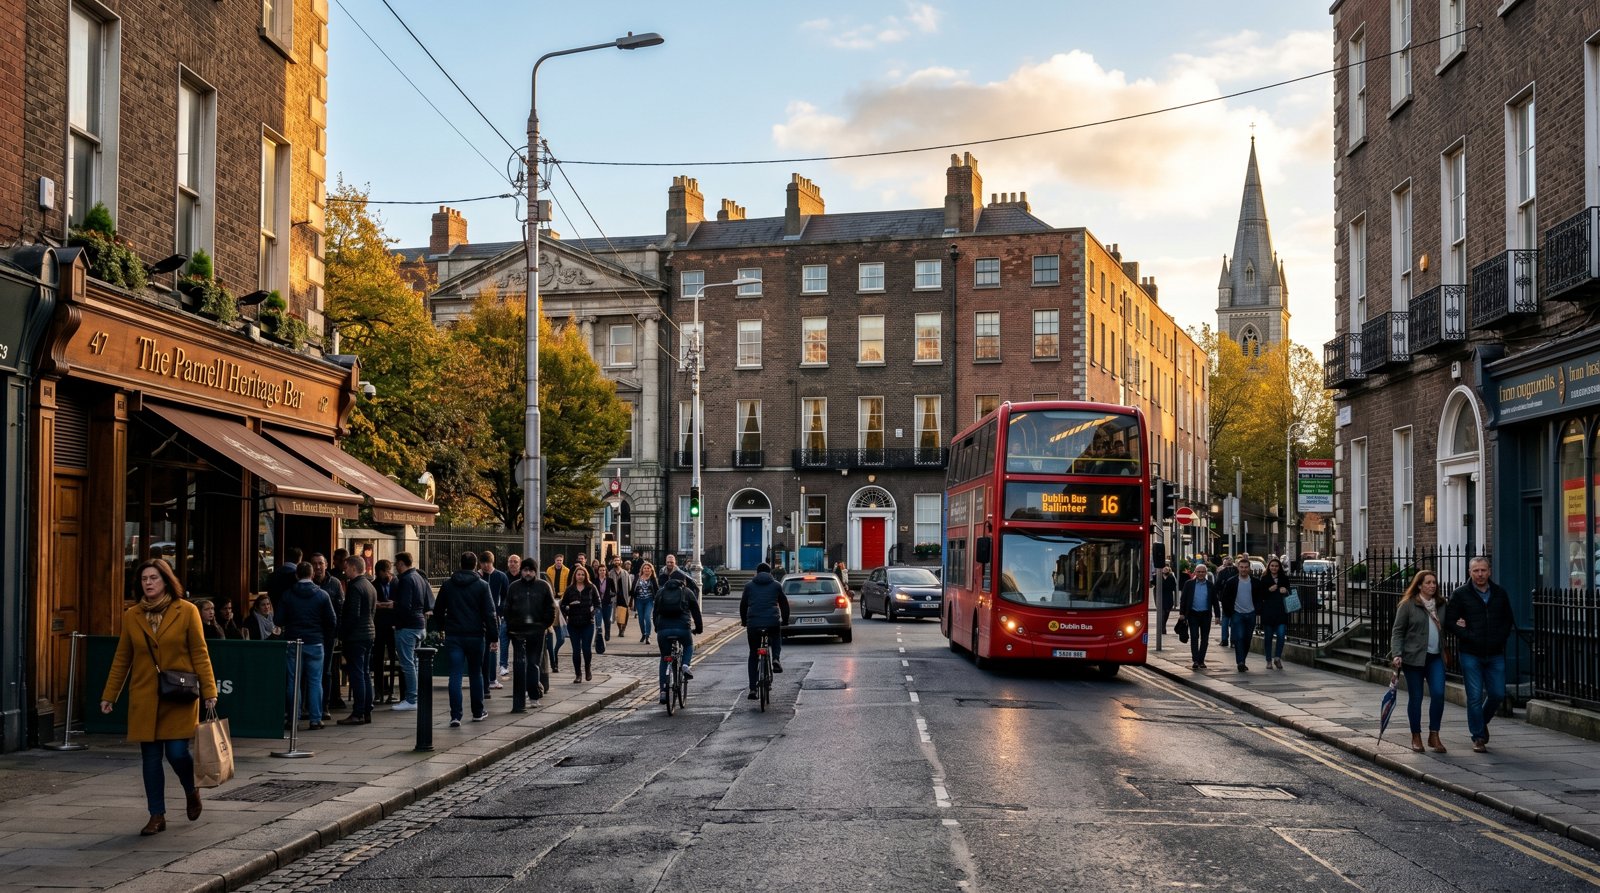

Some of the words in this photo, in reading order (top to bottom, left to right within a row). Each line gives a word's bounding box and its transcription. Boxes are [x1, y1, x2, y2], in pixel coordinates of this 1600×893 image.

[90, 331, 109, 356] 47
[138, 335, 170, 376] The
[173, 346, 226, 389] Parnell
[227, 362, 282, 409] Heritage
[282, 379, 305, 409] Bar
[1042, 493, 1069, 503] Dublin
[1071, 494, 1087, 503] Bus
[1101, 495, 1119, 514] 16
[1042, 503, 1087, 513] Ballinteer
